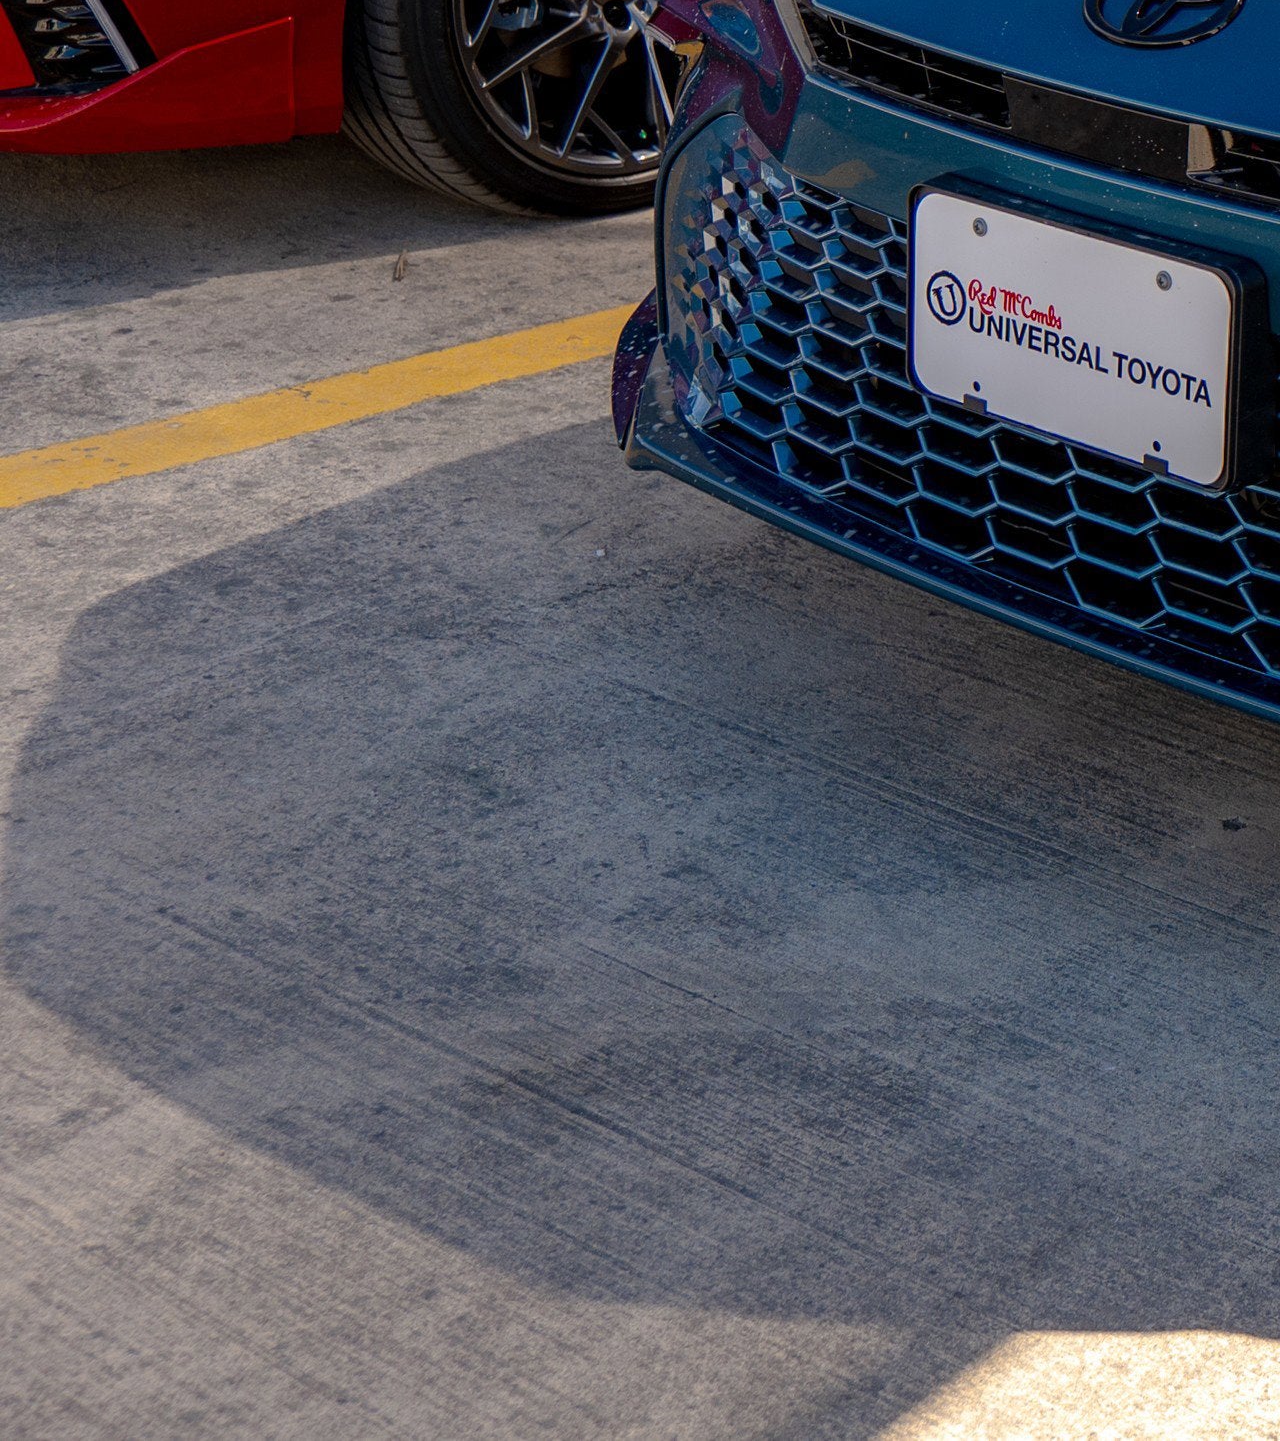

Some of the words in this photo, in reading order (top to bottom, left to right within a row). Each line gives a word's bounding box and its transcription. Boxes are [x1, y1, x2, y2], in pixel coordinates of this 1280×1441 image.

[968, 279, 997, 315] Red
[999, 288, 1062, 330] McCombs
[968, 306, 1109, 374] UNIVERSAL
[1112, 351, 1212, 408] TOYOTA
